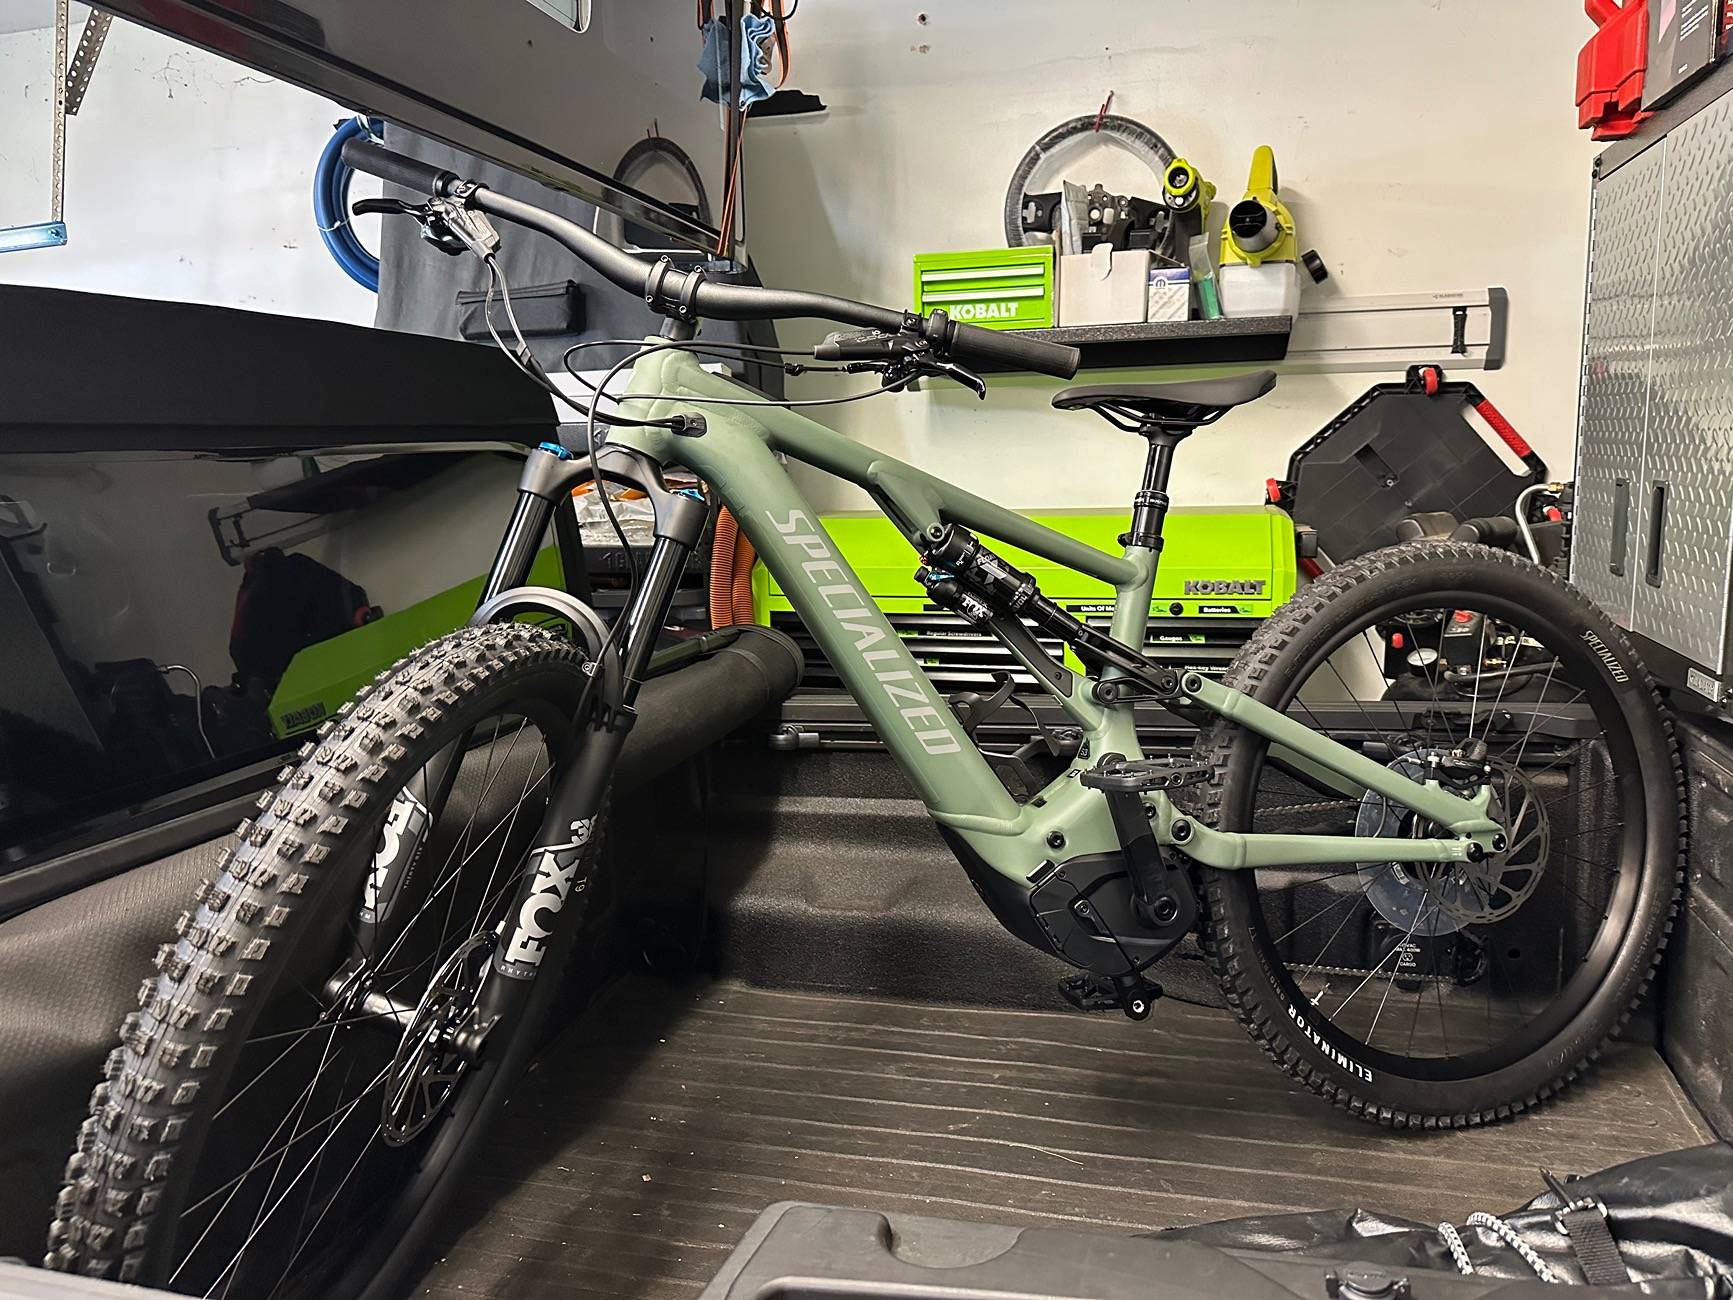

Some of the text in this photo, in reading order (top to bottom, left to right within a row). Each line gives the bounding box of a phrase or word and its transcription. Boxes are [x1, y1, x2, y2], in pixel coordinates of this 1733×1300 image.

[949, 302, 1018, 319] KOBALT
[961, 596, 984, 619] FOX
[1184, 580, 1266, 596] KOBALT
[765, 509, 961, 755] SPECIALIZED
[1579, 630, 1629, 683] SPECIALIZED
[504, 851, 581, 967] FOX
[1287, 1004, 1373, 1083] ELIMINATOR
